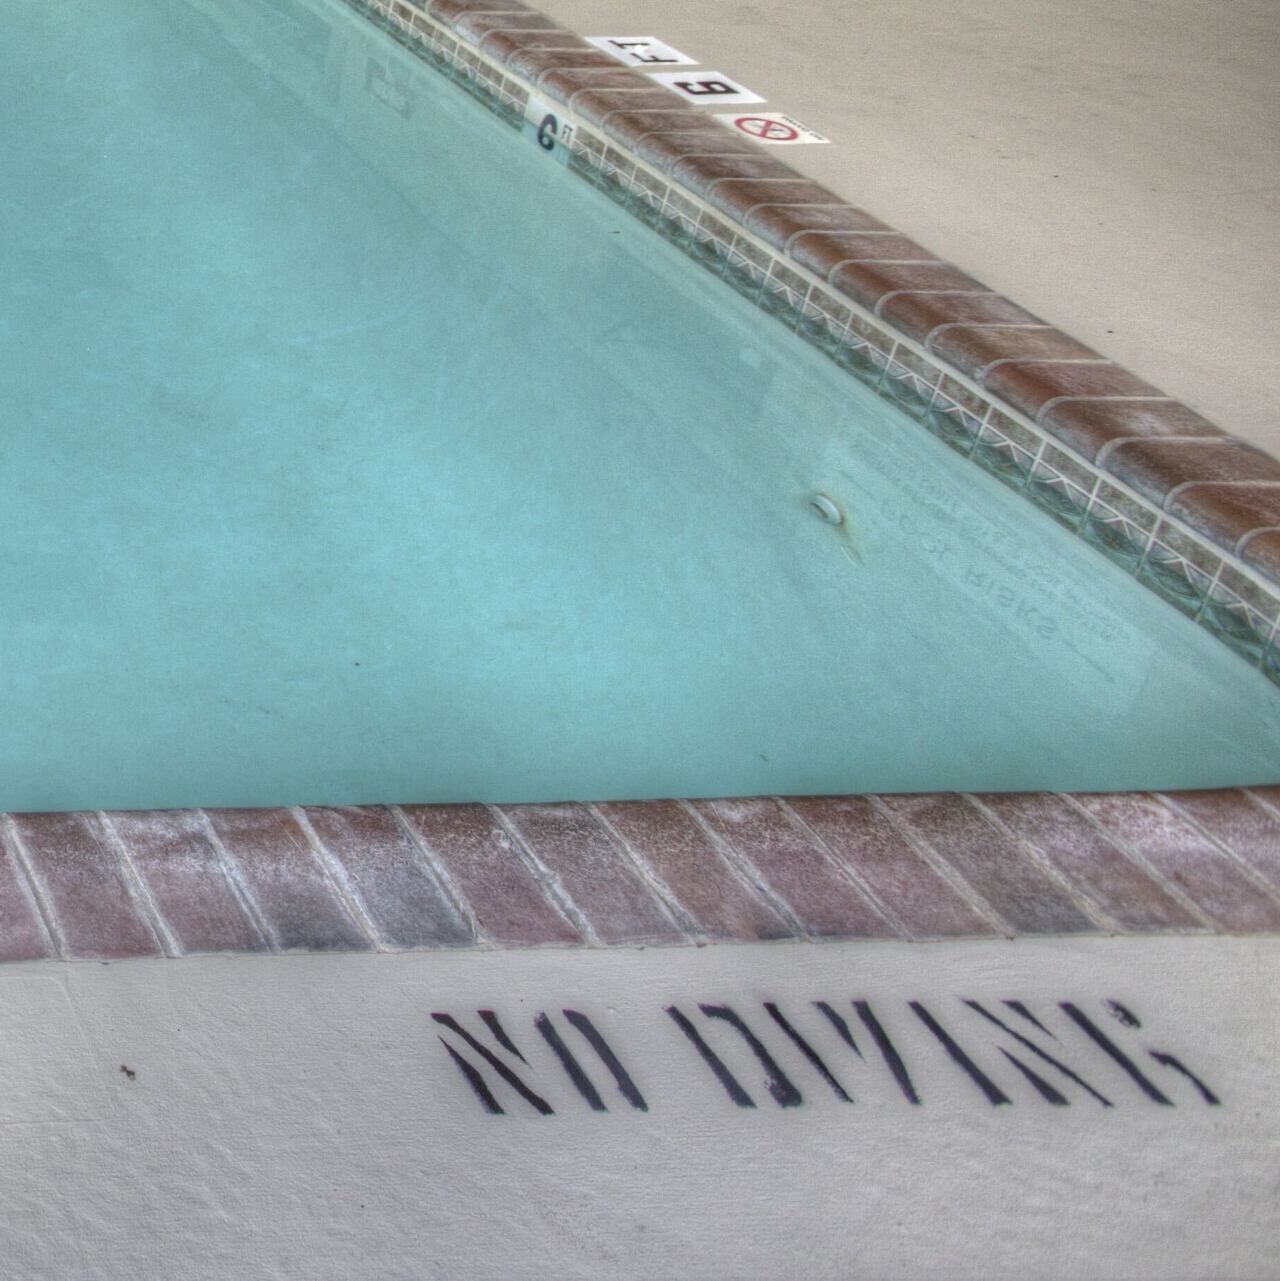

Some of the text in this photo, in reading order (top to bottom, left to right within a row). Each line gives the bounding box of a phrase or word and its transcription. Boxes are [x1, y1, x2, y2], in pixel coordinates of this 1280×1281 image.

[609, 38, 679, 64] FT
[536, 113, 556, 151] 6
[430, 995, 1222, 1115] NO DIVING
